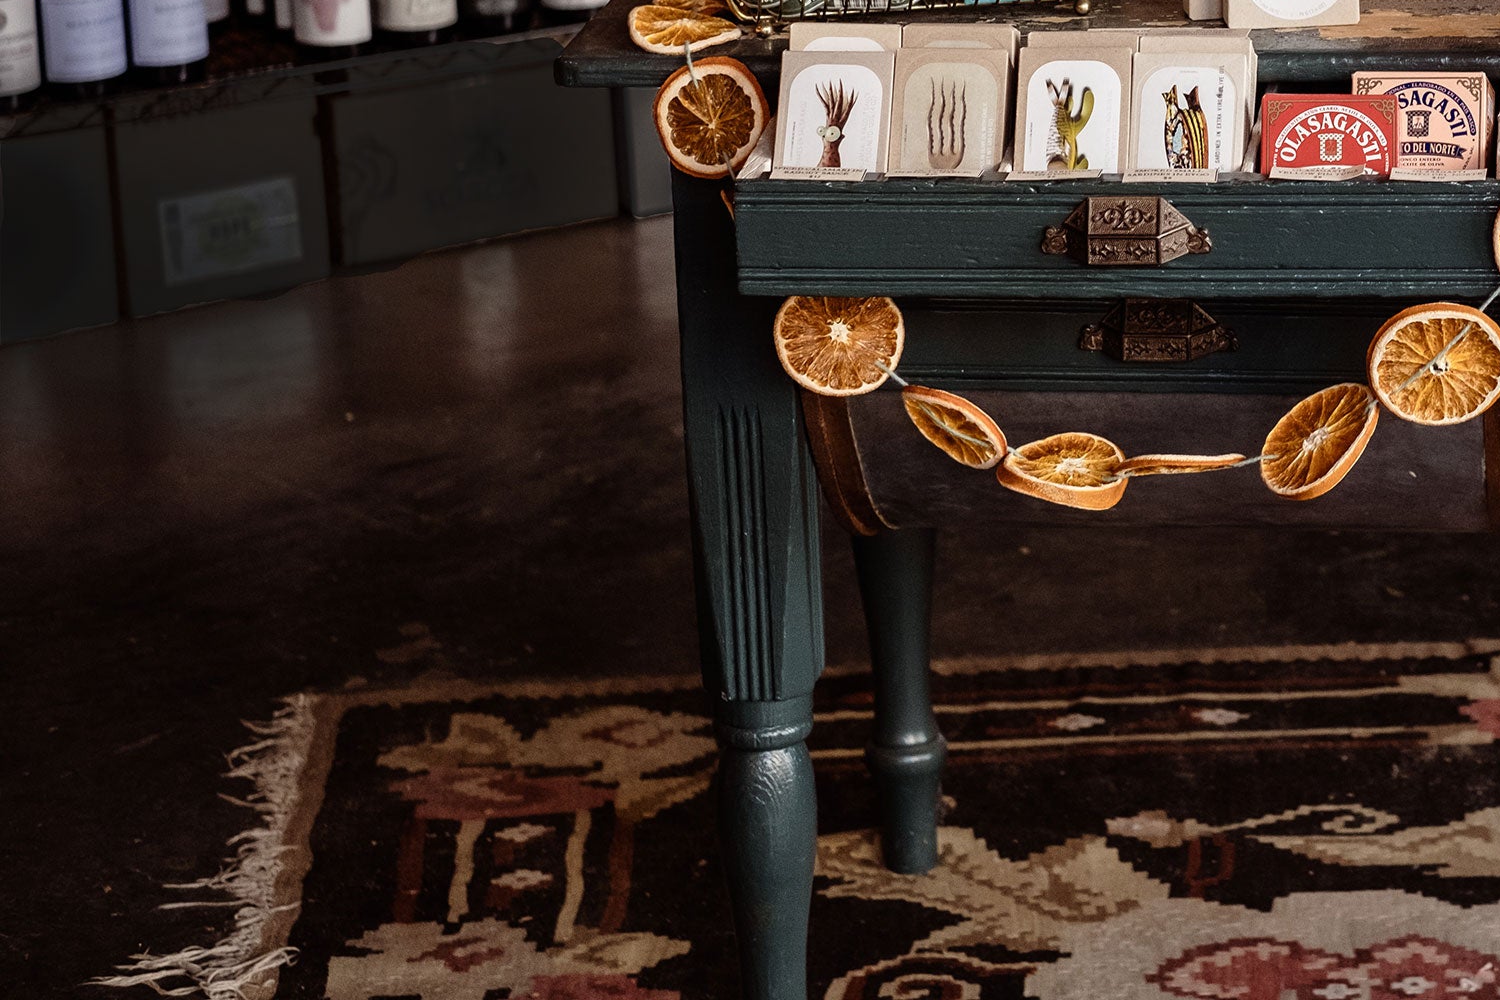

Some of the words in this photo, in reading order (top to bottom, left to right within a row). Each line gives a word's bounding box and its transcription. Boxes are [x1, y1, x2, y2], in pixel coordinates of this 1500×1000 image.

[1398, 90, 1468, 138] SAGASTI
[1411, 82, 1447, 93] ELABORADO
[1468, 113, 1476, 133] VASCO
[1280, 112, 1382, 162] OLASAGASTI
[1413, 143, 1427, 153] DEL
[1430, 143, 1456, 155] NORTE
